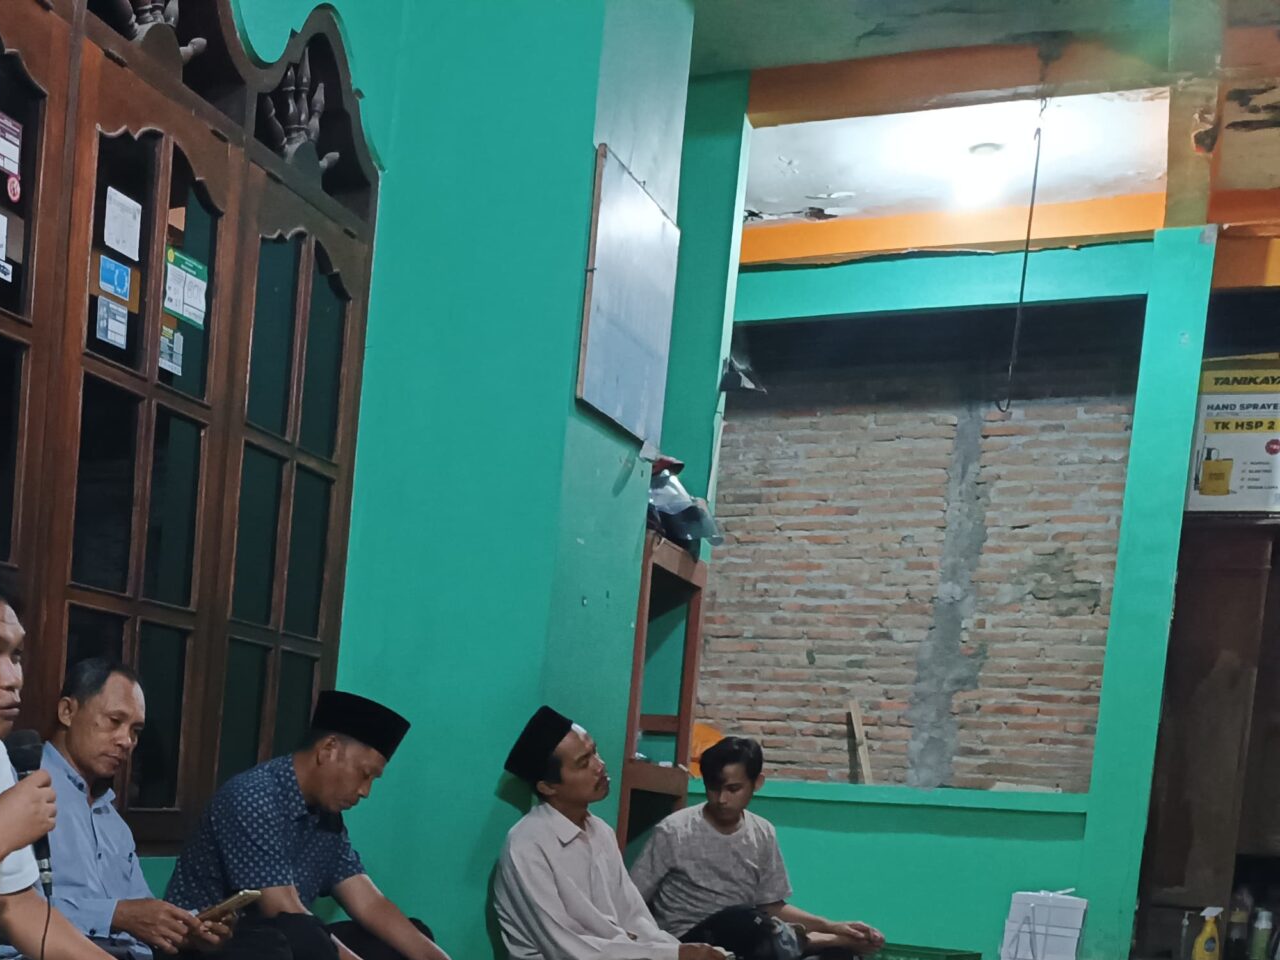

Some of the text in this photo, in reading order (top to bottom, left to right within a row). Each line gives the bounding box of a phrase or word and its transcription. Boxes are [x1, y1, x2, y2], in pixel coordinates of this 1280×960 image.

[1206, 403, 1237, 411] HAND
[1214, 420, 1275, 430] TK HSP 2
